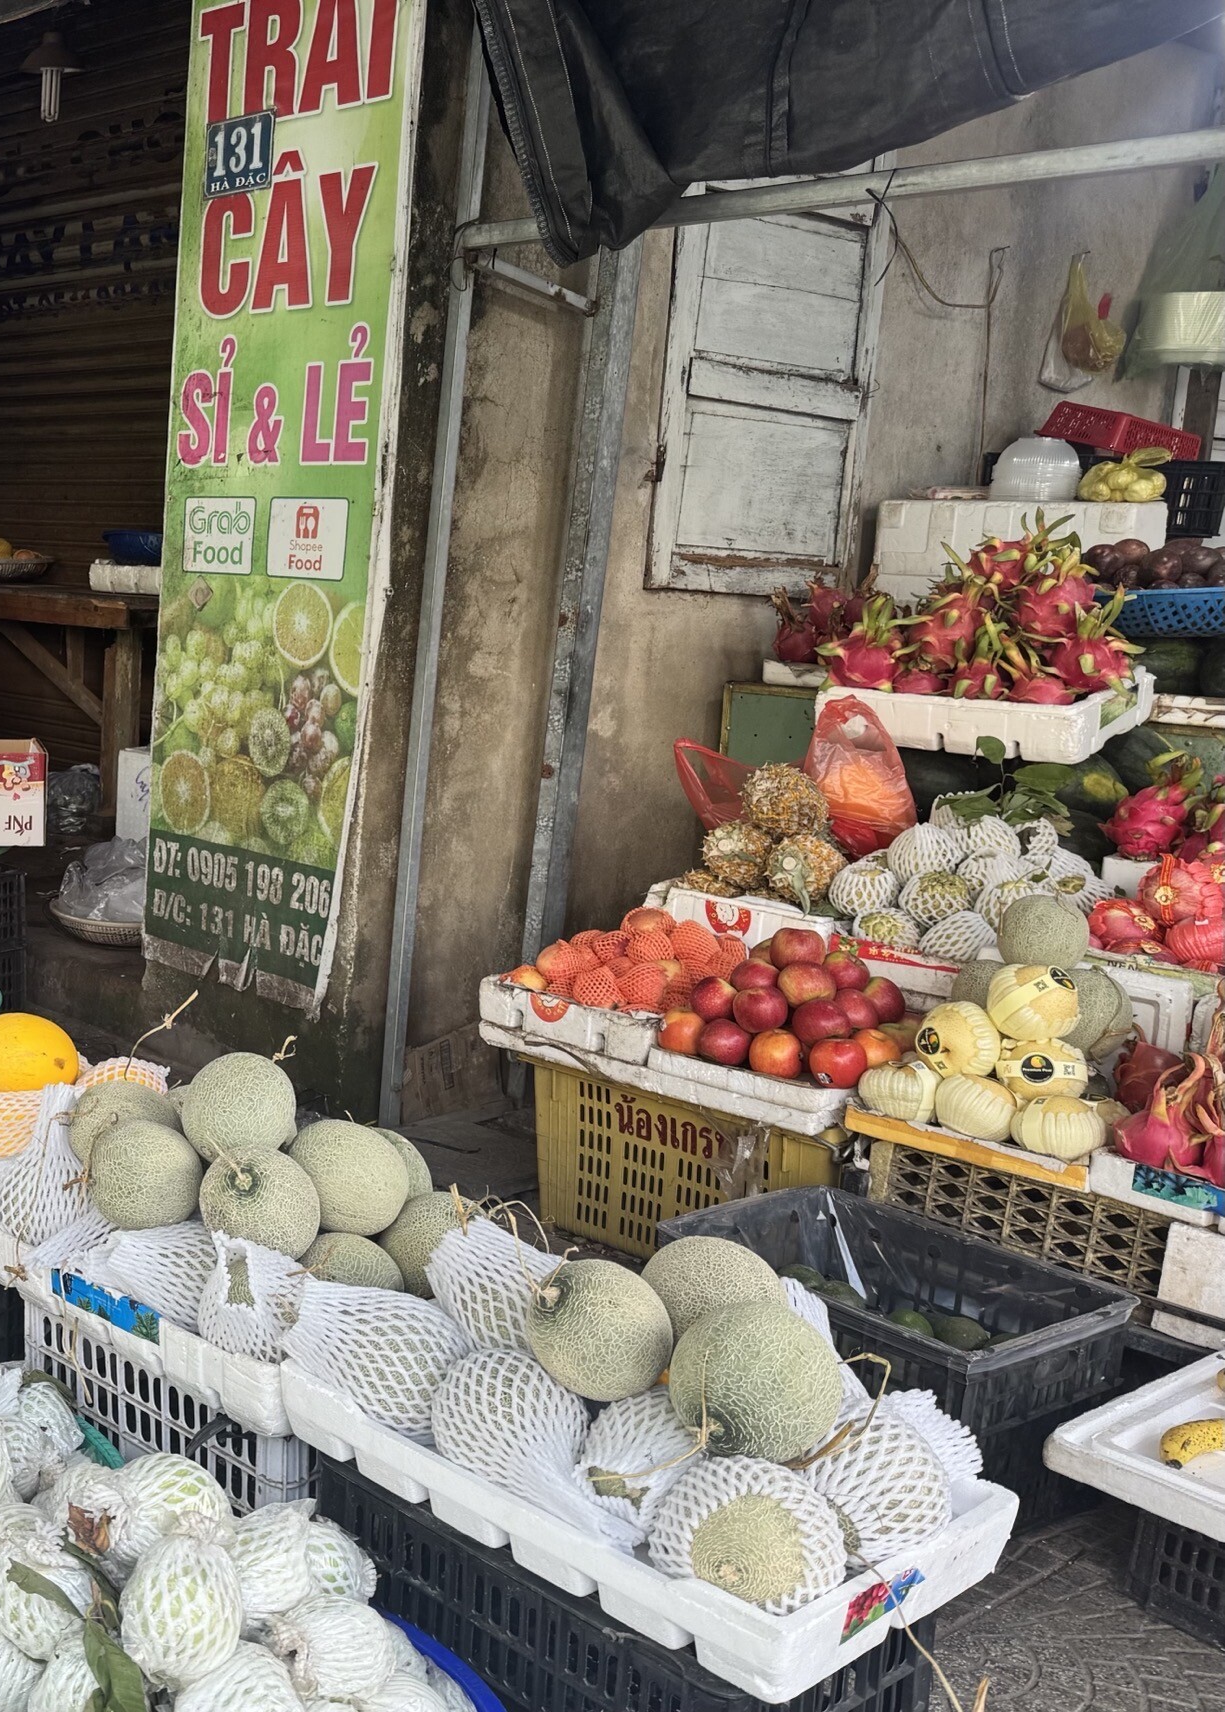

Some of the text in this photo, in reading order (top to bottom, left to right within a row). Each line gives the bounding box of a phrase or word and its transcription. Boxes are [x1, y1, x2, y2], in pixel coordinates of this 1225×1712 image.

[213, 122, 263, 177] 131
[210, 172, 266, 192] HÀ ĐẶC
[200, 148, 378, 318] CÂY
[177, 321, 374, 467] SỈ & LẺ
[189, 501, 250, 535] Grab
[193, 541, 243, 565] Food
[288, 554, 322, 571] Food
[289, 540, 323, 554] Shopee
[4, 815, 33, 836] PNF
[153, 837, 331, 918] ĐT: 0905 198 206
[152, 888, 323, 968] Đ/C: 131 HÀ ĐẶC
